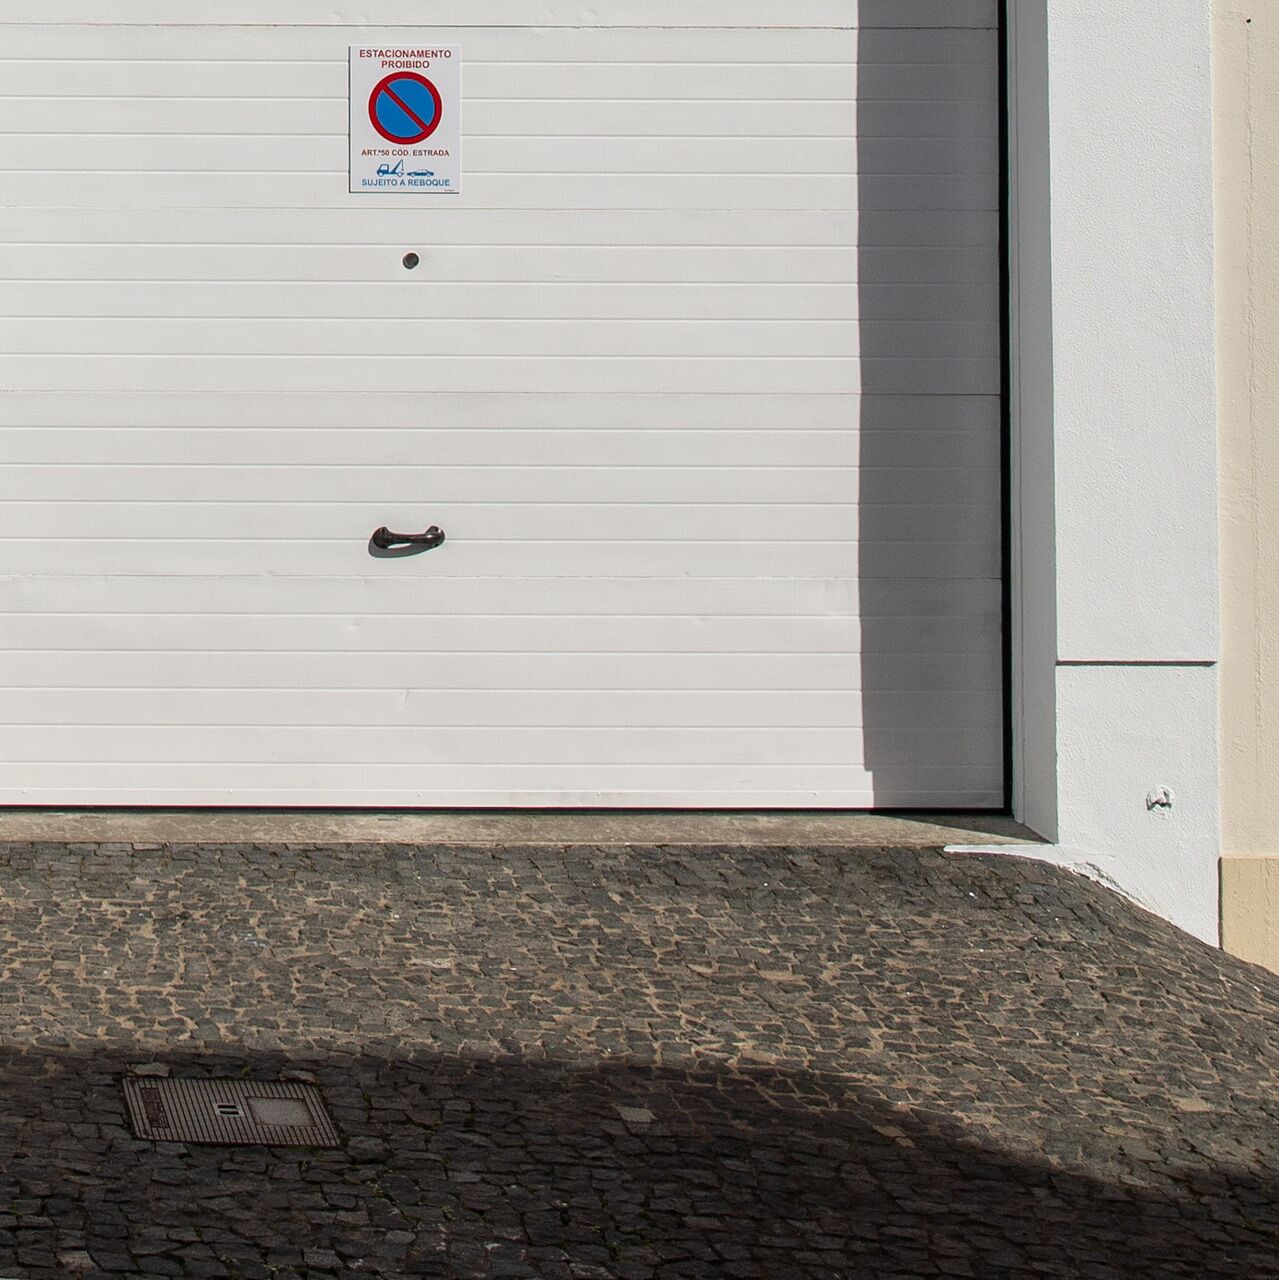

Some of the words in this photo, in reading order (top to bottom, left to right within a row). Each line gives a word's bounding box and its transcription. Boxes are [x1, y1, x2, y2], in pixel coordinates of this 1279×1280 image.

[359, 49, 452, 58] ESTACIONAMENTO
[381, 60, 430, 68] PROIBIDO
[412, 149, 450, 157] ESTRADA
[361, 178, 397, 187] SUJEITO
[400, 178, 407, 186] A
[407, 178, 450, 187] REBOQUE
